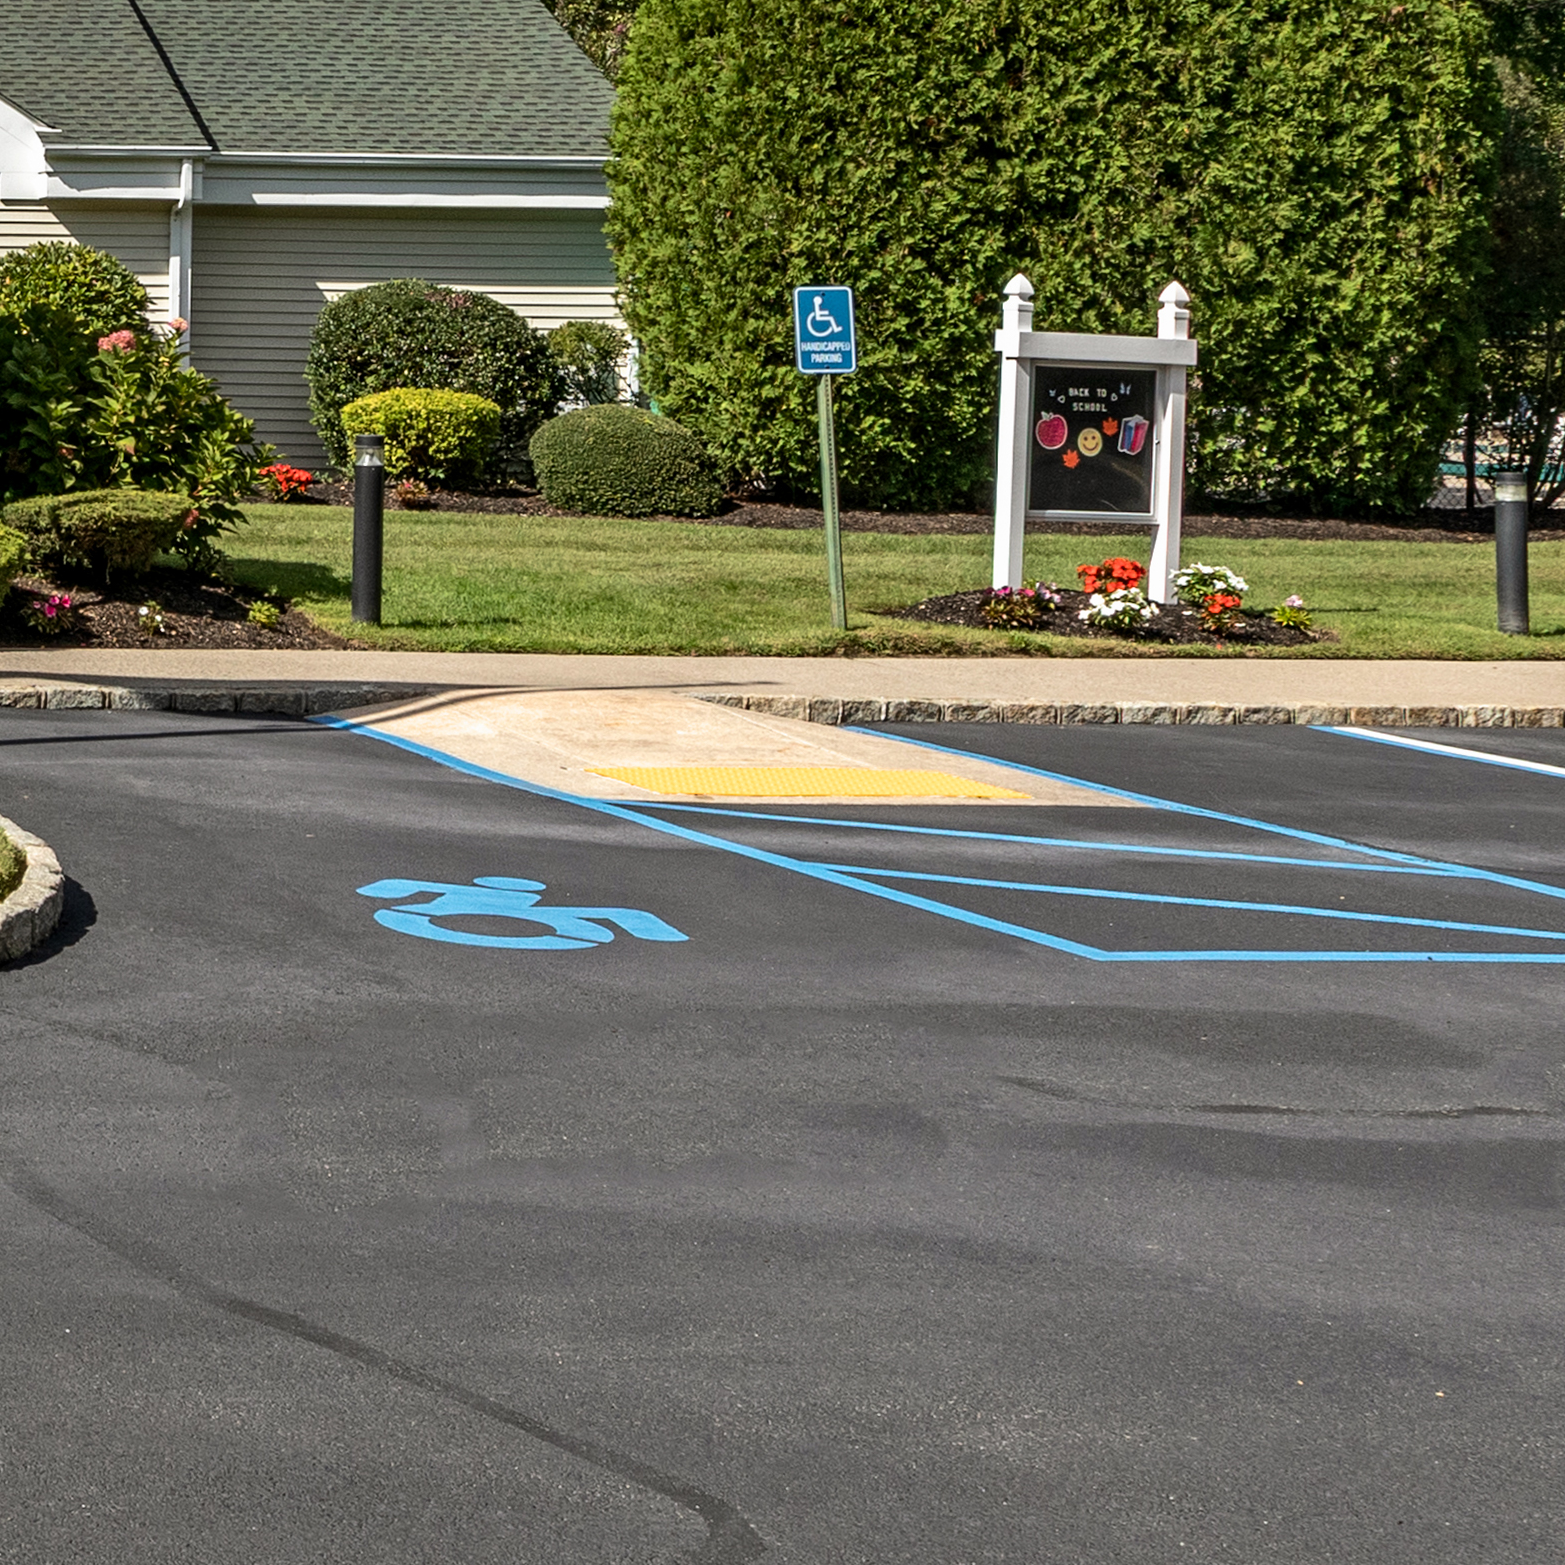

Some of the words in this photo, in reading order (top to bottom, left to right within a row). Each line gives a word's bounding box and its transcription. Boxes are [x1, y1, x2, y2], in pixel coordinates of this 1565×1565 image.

[800, 341, 851, 352] HANDICAPPED
[810, 353, 843, 364] PARKING
[1068, 387, 1090, 397] BACK
[1096, 388, 1107, 398] TO
[1072, 402, 1108, 412] SCHOOL
